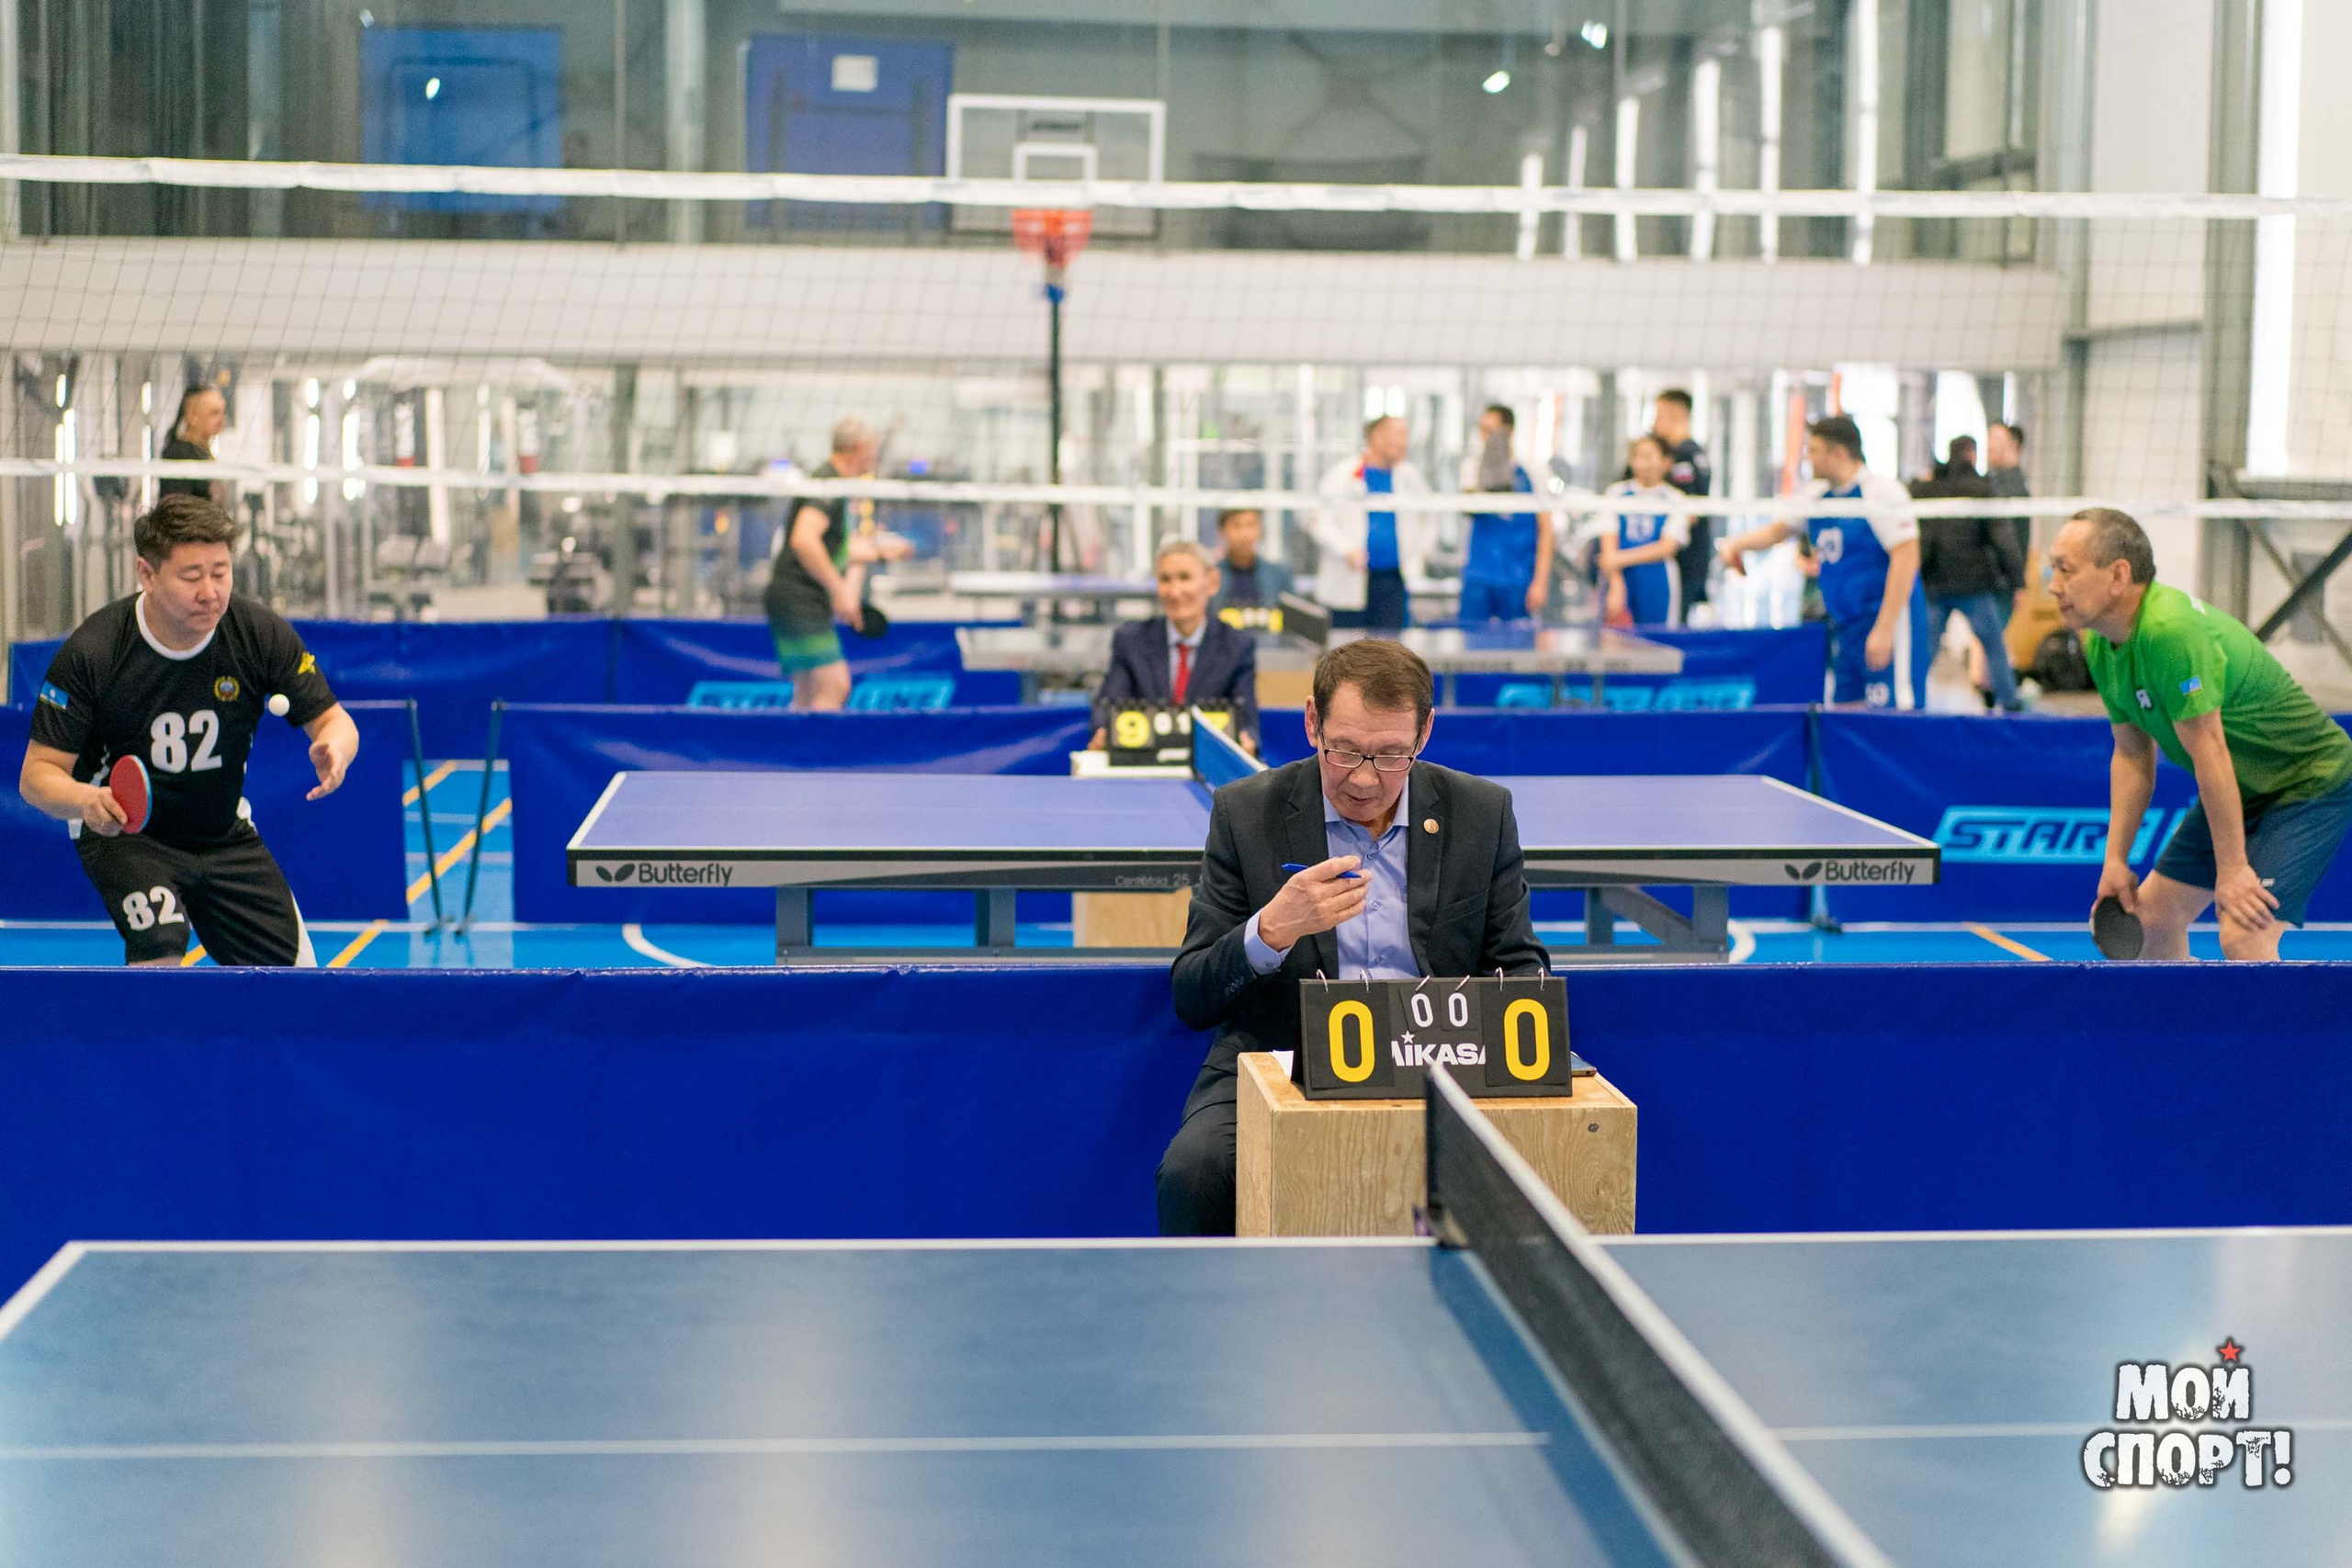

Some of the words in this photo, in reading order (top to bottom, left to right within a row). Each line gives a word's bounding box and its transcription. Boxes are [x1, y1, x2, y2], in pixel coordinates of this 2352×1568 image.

[150, 709, 222, 773] 82
[1115, 710, 1150, 748] 9
[1947, 820, 2147, 852] STAR
[638, 863, 733, 886] Butterfly
[1825, 861, 1915, 884] Butterfly
[122, 886, 185, 931] 82
[1329, 999, 1375, 1083] 0
[1410, 993, 1433, 1027] 0
[1448, 992, 1468, 1027] 0
[1503, 998, 1550, 1081] 0
